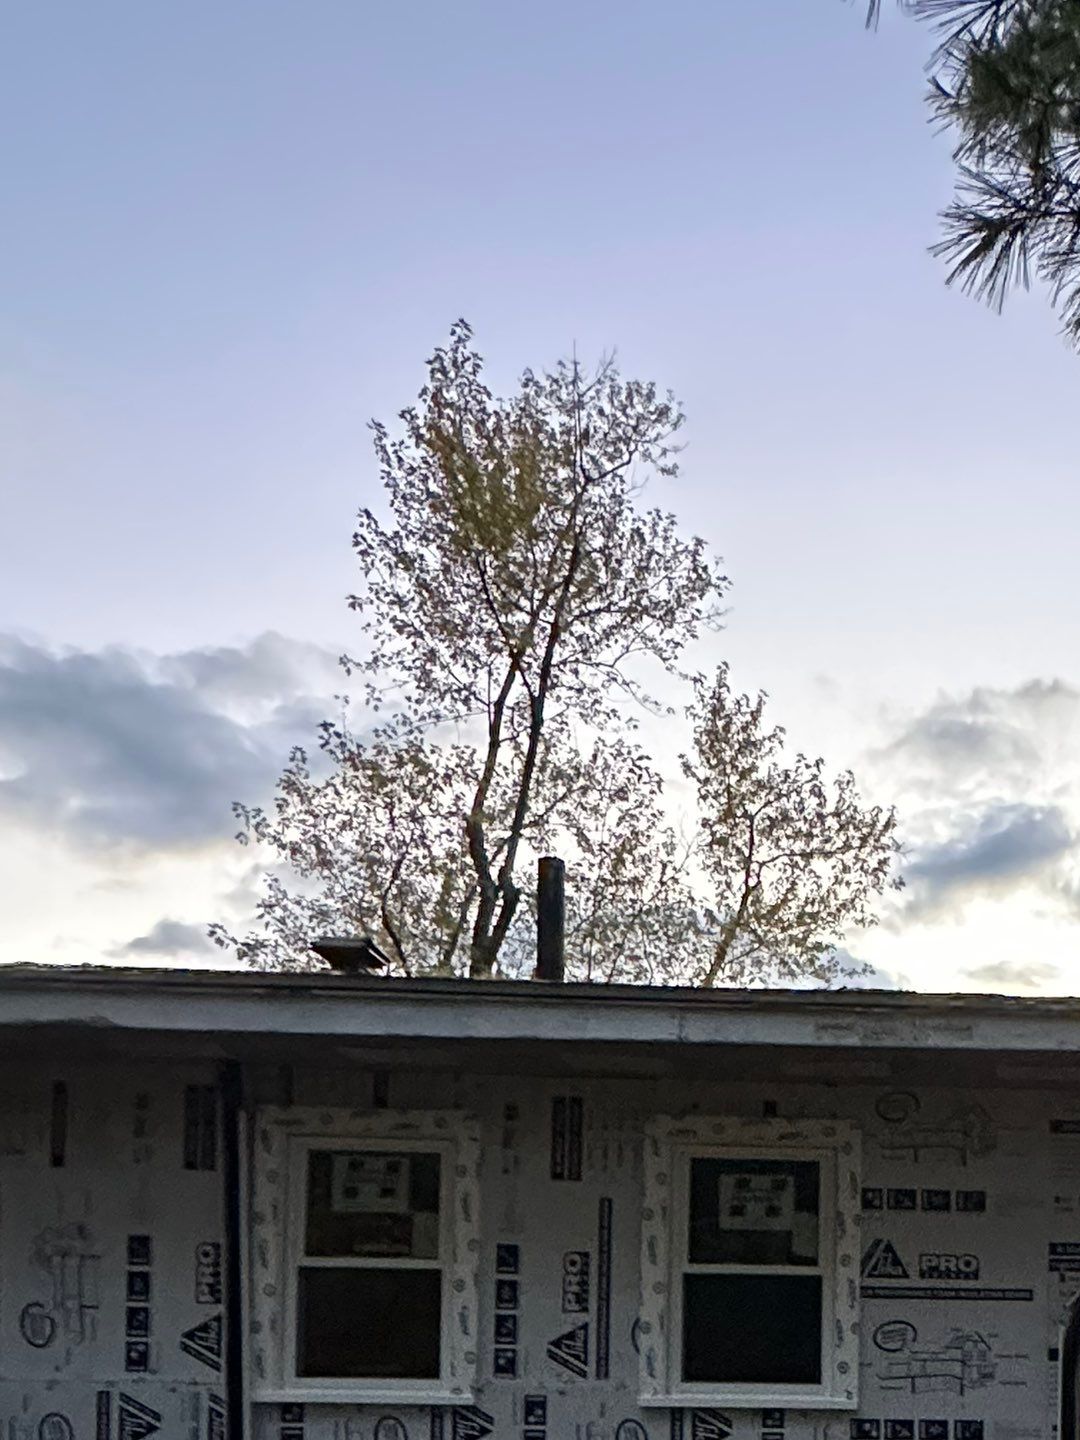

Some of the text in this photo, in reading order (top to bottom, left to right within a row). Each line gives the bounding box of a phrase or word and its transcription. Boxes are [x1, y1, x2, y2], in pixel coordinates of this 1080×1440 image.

[197, 1244, 214, 1302] PRO
[565, 1252, 580, 1312] PRO
[920, 1254, 979, 1273] PRO
